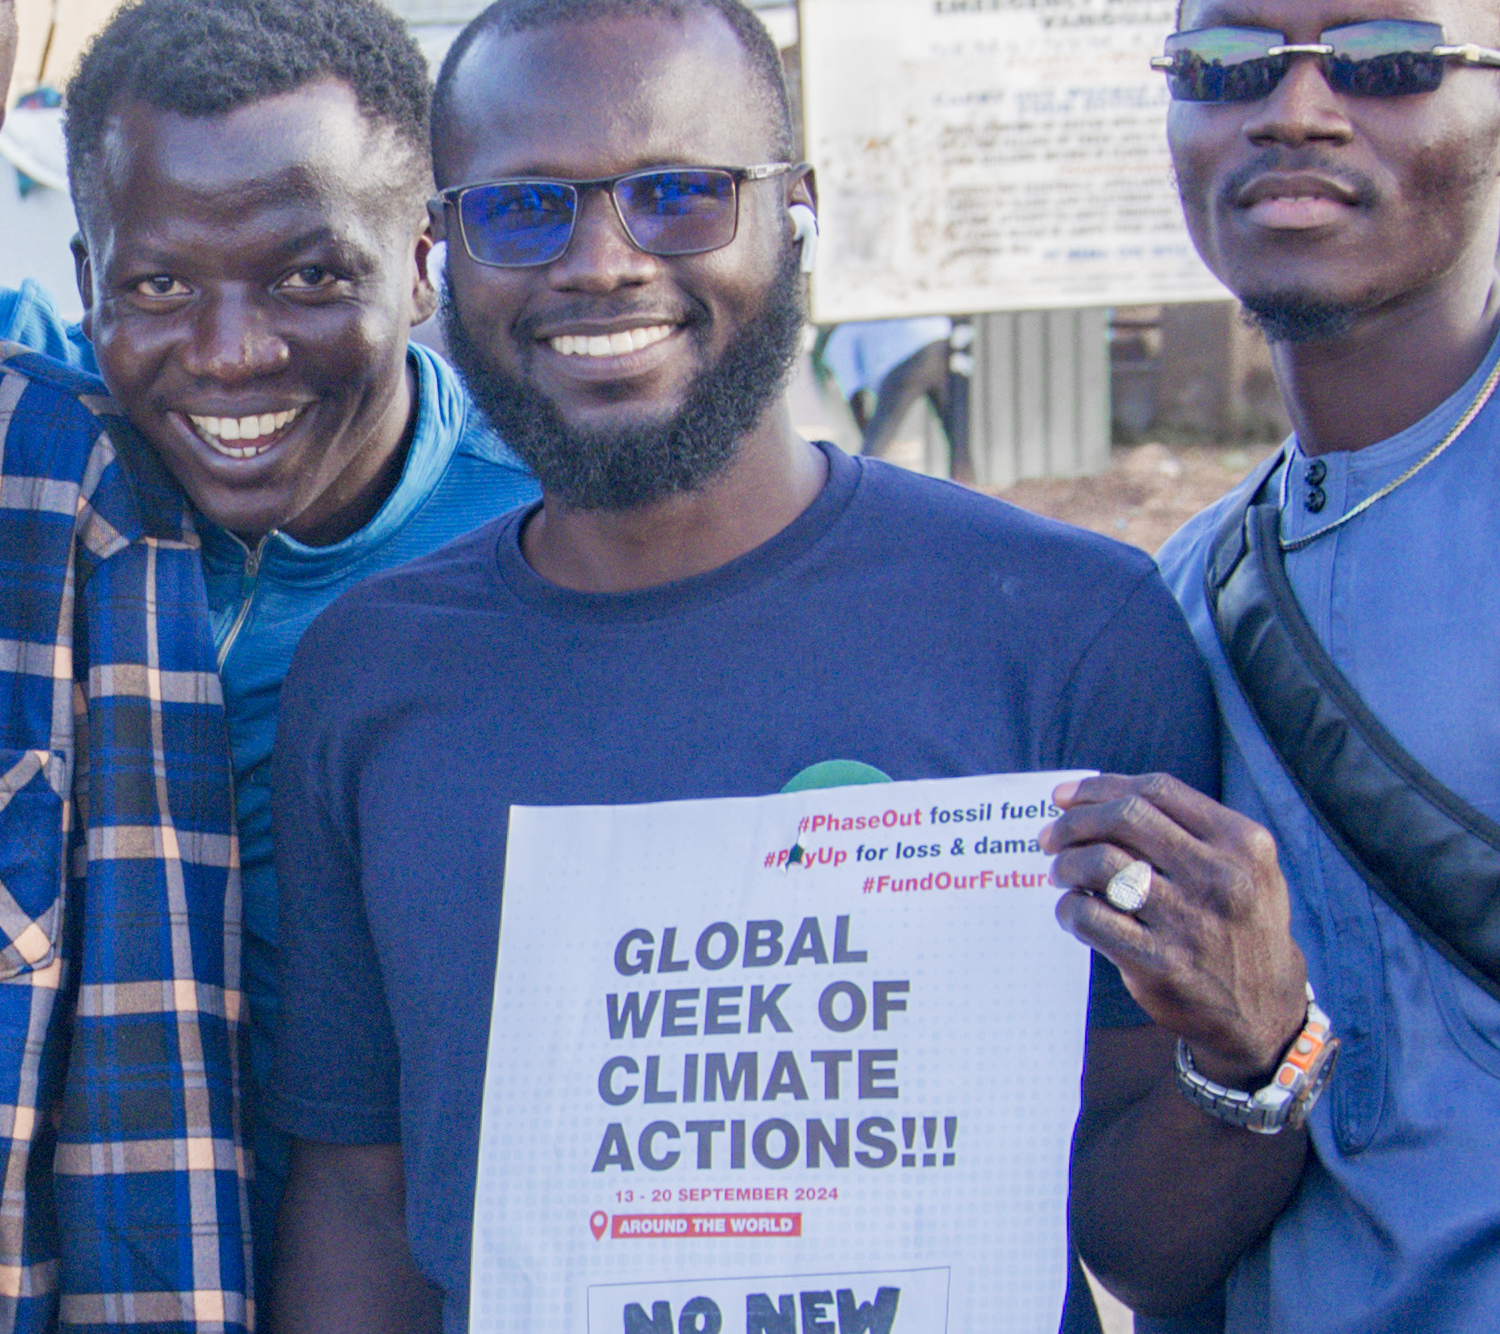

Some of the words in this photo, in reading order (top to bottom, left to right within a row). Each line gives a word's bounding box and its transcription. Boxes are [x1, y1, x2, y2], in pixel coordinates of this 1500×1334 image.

[799, 807, 923, 833] #PhaseOut
[929, 803, 992, 825] fossil
[999, 799, 1061, 820] fuels
[855, 842, 889, 863] for
[894, 838, 943, 860] loss
[950, 837, 966, 857] &
[972, 834, 1042, 856] dama
[613, 913, 868, 977] GLOBAL
[604, 983, 794, 1041] WEEK
[817, 978, 911, 1033] OF
[597, 1047, 900, 1107] CLIMATE
[590, 1114, 959, 1173] ACTIONS!!!
[614, 1188, 635, 1203] 13
[650, 1188, 672, 1203] 20
[677, 1186, 790, 1203] SEPTEMBER
[794, 1186, 839, 1202] 2024
[618, 1218, 689, 1235] AROUND
[691, 1216, 728, 1234] THE
[730, 1214, 794, 1233] WORLD
